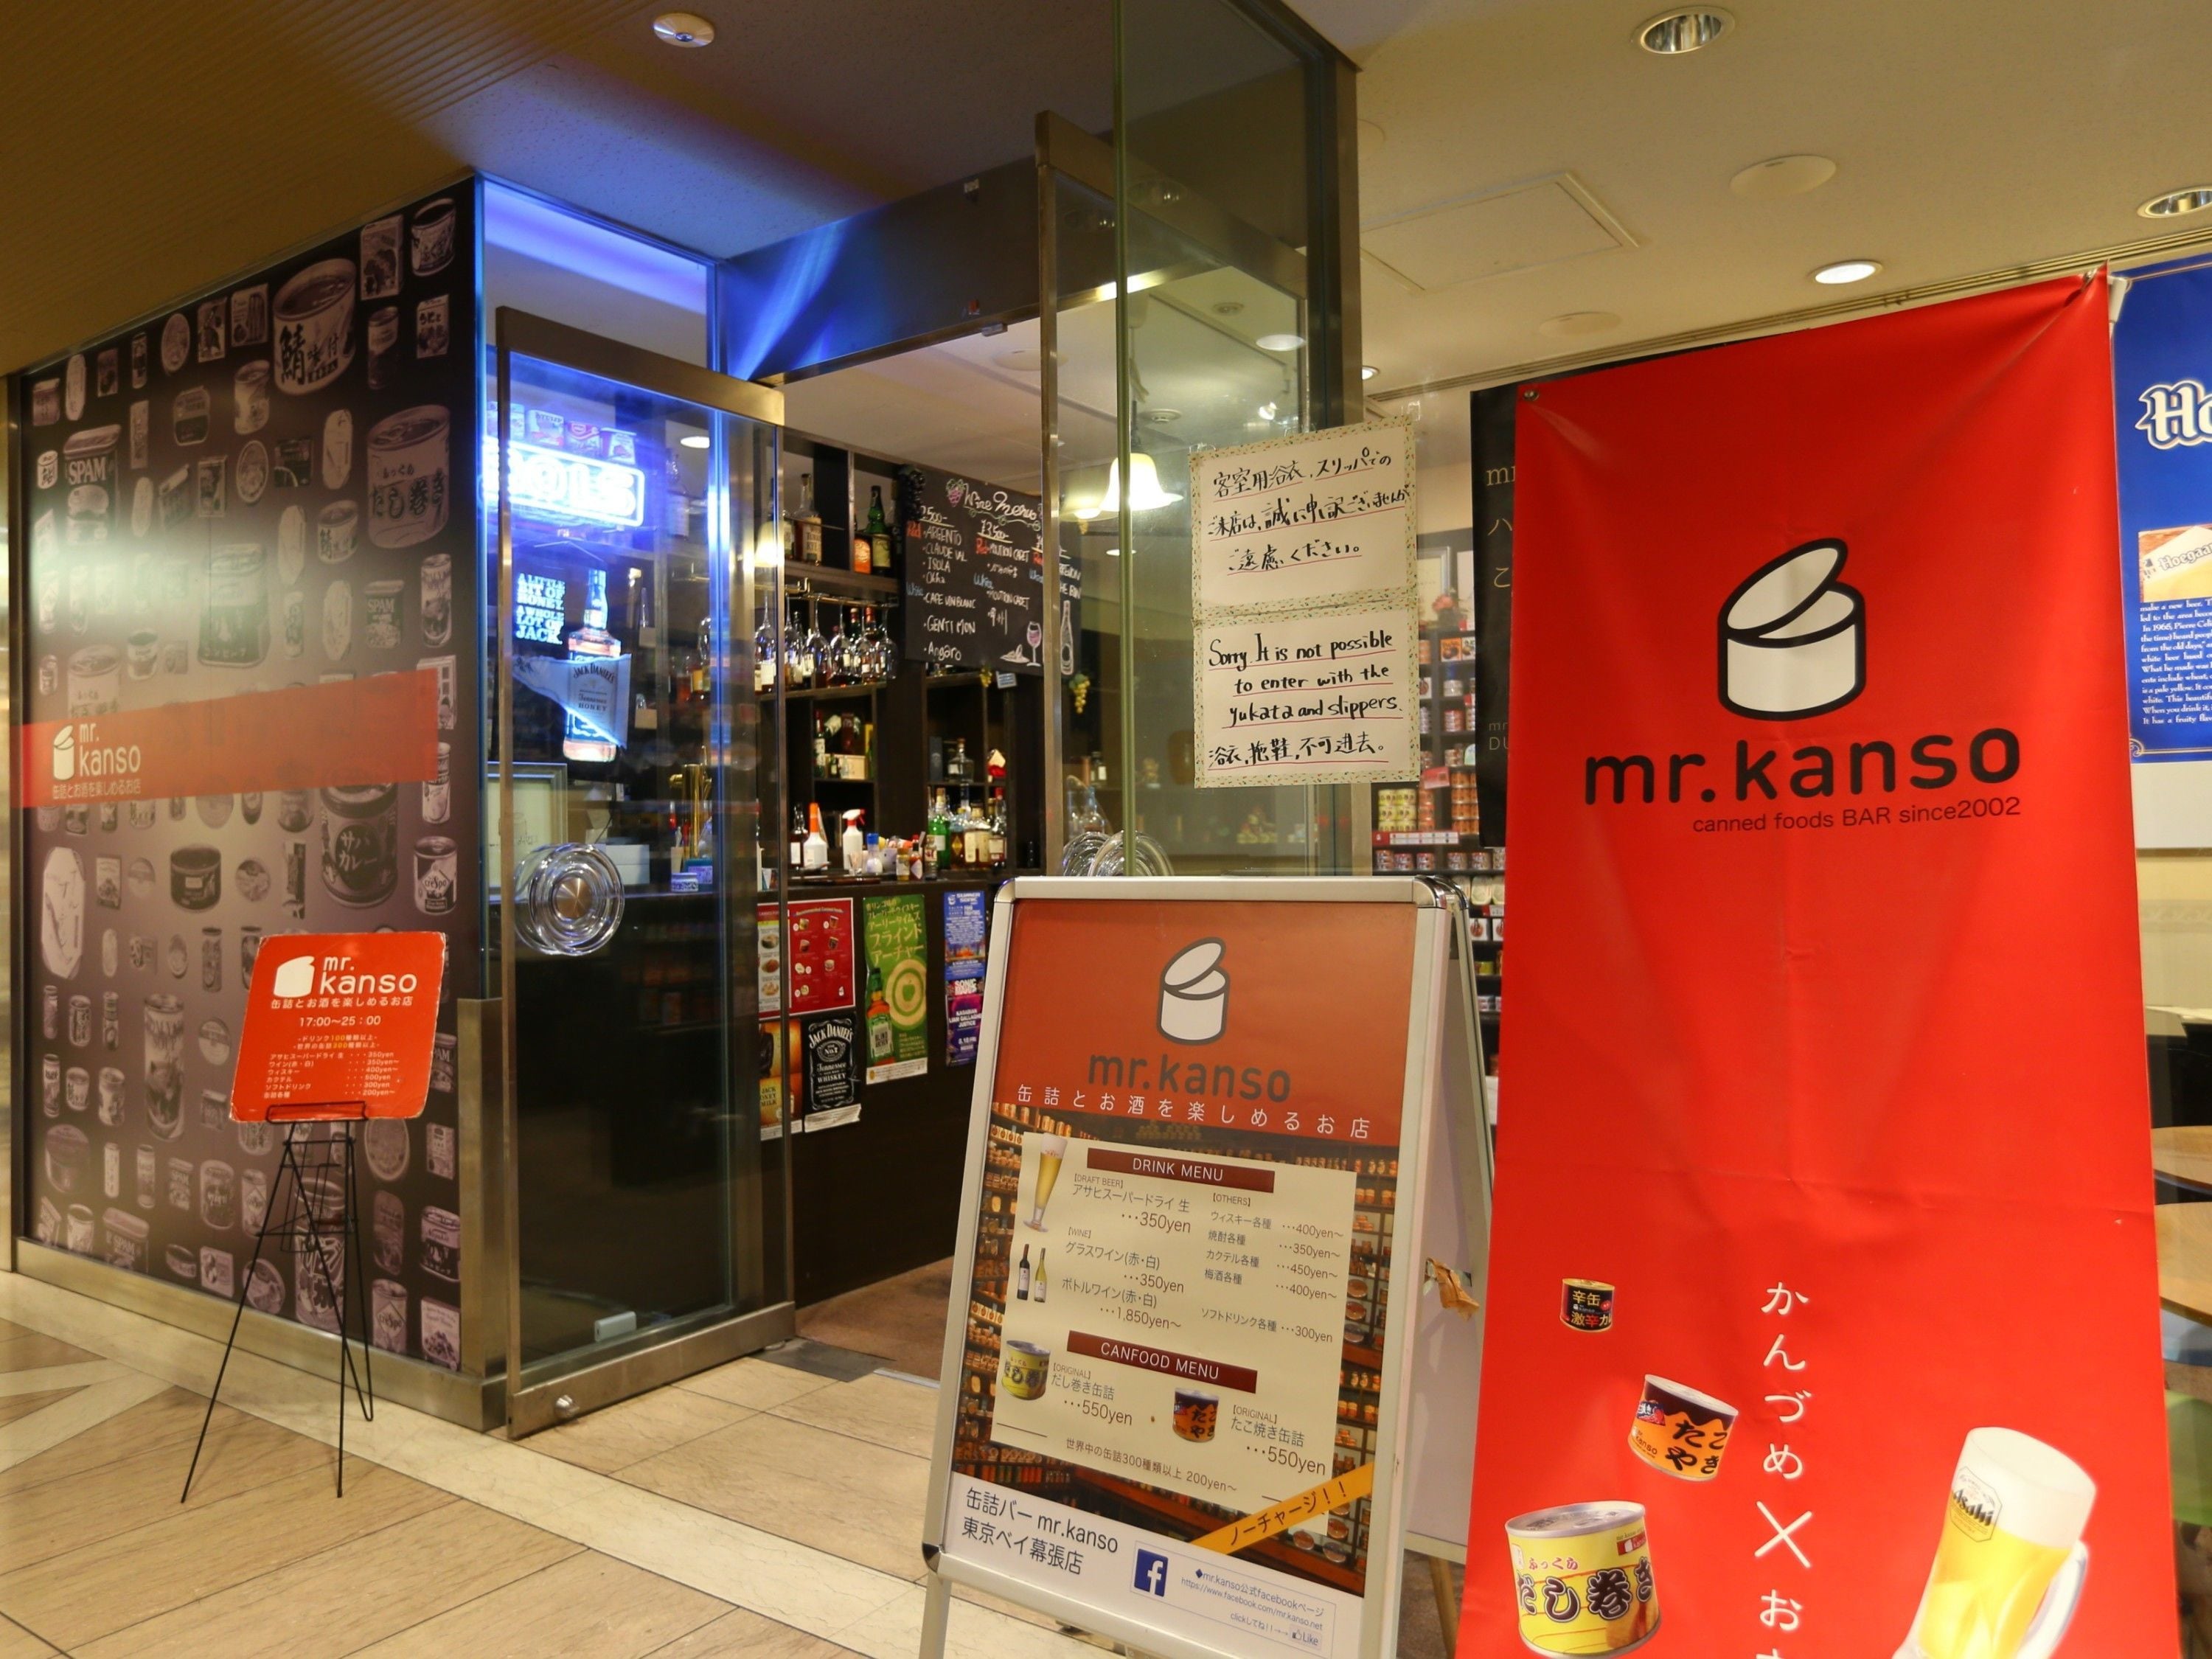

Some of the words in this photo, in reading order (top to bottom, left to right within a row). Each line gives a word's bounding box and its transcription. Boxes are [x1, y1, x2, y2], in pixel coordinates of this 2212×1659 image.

[69, 456, 107, 486] SPAM
[2140, 602, 2160, 612] make
[2163, 611, 2174, 620] the
[2174, 622, 2196, 630] Pierre
[1275, 645, 1289, 661] is
[1295, 643, 1323, 659] not
[1330, 629, 1393, 661] possible
[2140, 634, 2152, 643] the
[2173, 630, 2194, 640] heard
[2140, 644, 2159, 653] from
[2160, 643, 2171, 651] the
[2141, 654, 2161, 663] white
[2141, 665, 2162, 673] What
[2163, 664, 2173, 672] he
[2174, 661, 2194, 671] made
[1234, 678, 1253, 695] to
[1260, 676, 1310, 690] enter
[1317, 668, 1354, 687] with
[1359, 664, 1390, 681] the
[2157, 672, 2183, 683] include
[2154, 684, 2168, 695] pale
[2165, 694, 2183, 703] This
[1229, 701, 1294, 729] yukata
[1297, 699, 1324, 717] and
[2142, 706, 2166, 714] When
[2180, 703, 2202, 712] drink
[2152, 716, 2164, 724] has
[2175, 714, 2197, 724] fruity
[80, 745, 141, 777] kanso
[1585, 727, 2021, 806] mr.kanso
[1692, 813, 1767, 832] canned
[1773, 810, 1834, 830] foods
[1842, 807, 1891, 827] BAR
[1898, 796, 2021, 825] since2002
[323, 956, 355, 971] mr.
[320, 971, 417, 995] kanso
[271, 995, 414, 1009] 缶詰とお酒を楽しめるお店
[809, 1029, 827, 1048] JACK
[817, 1072, 846, 1084] WHISKEY
[1088, 1051, 1292, 1104] mr.kanso
[1016, 1083, 1371, 1140] 缶詰とお酒を楽しめるお店
[1133, 1158, 1175, 1175] DRINK
[1181, 1164, 1223, 1181] MENU
[1073, 1184, 1175, 1210] アサヒスーパードライ
[1178, 1198, 1190, 1214] 生
[1211, 1211, 1272, 1230] ウィスキー各種
[1208, 1230, 1246, 1246] 焼酎各種
[1206, 1248, 1259, 1268] カクテル各種
[1204, 1267, 1242, 1286] 梅酒各種
[1573, 1290, 1601, 1307] 辛缶
[1201, 1307, 1277, 1333] ソフトドリンク各種
[1100, 1342, 1170, 1368] CANFOOD
[1175, 1357, 1219, 1380] MENU
[1051, 1373, 1116, 1401] だし巻き缶詰
[1231, 1416, 1305, 1447] たこ焼き缶詰
[1066, 1437, 1183, 1481] 世界中の缶詰300種類以上
[966, 1486, 1032, 1521] 缶詰バー
[1037, 1514, 1119, 1554] mr.kanso
[961, 1516, 1084, 1576] 東京ベイ幕張店
[1181, 1576, 1323, 1631] https://www.facebook.com/mr.kanso.net
[1302, 1632, 1319, 1646] Like
